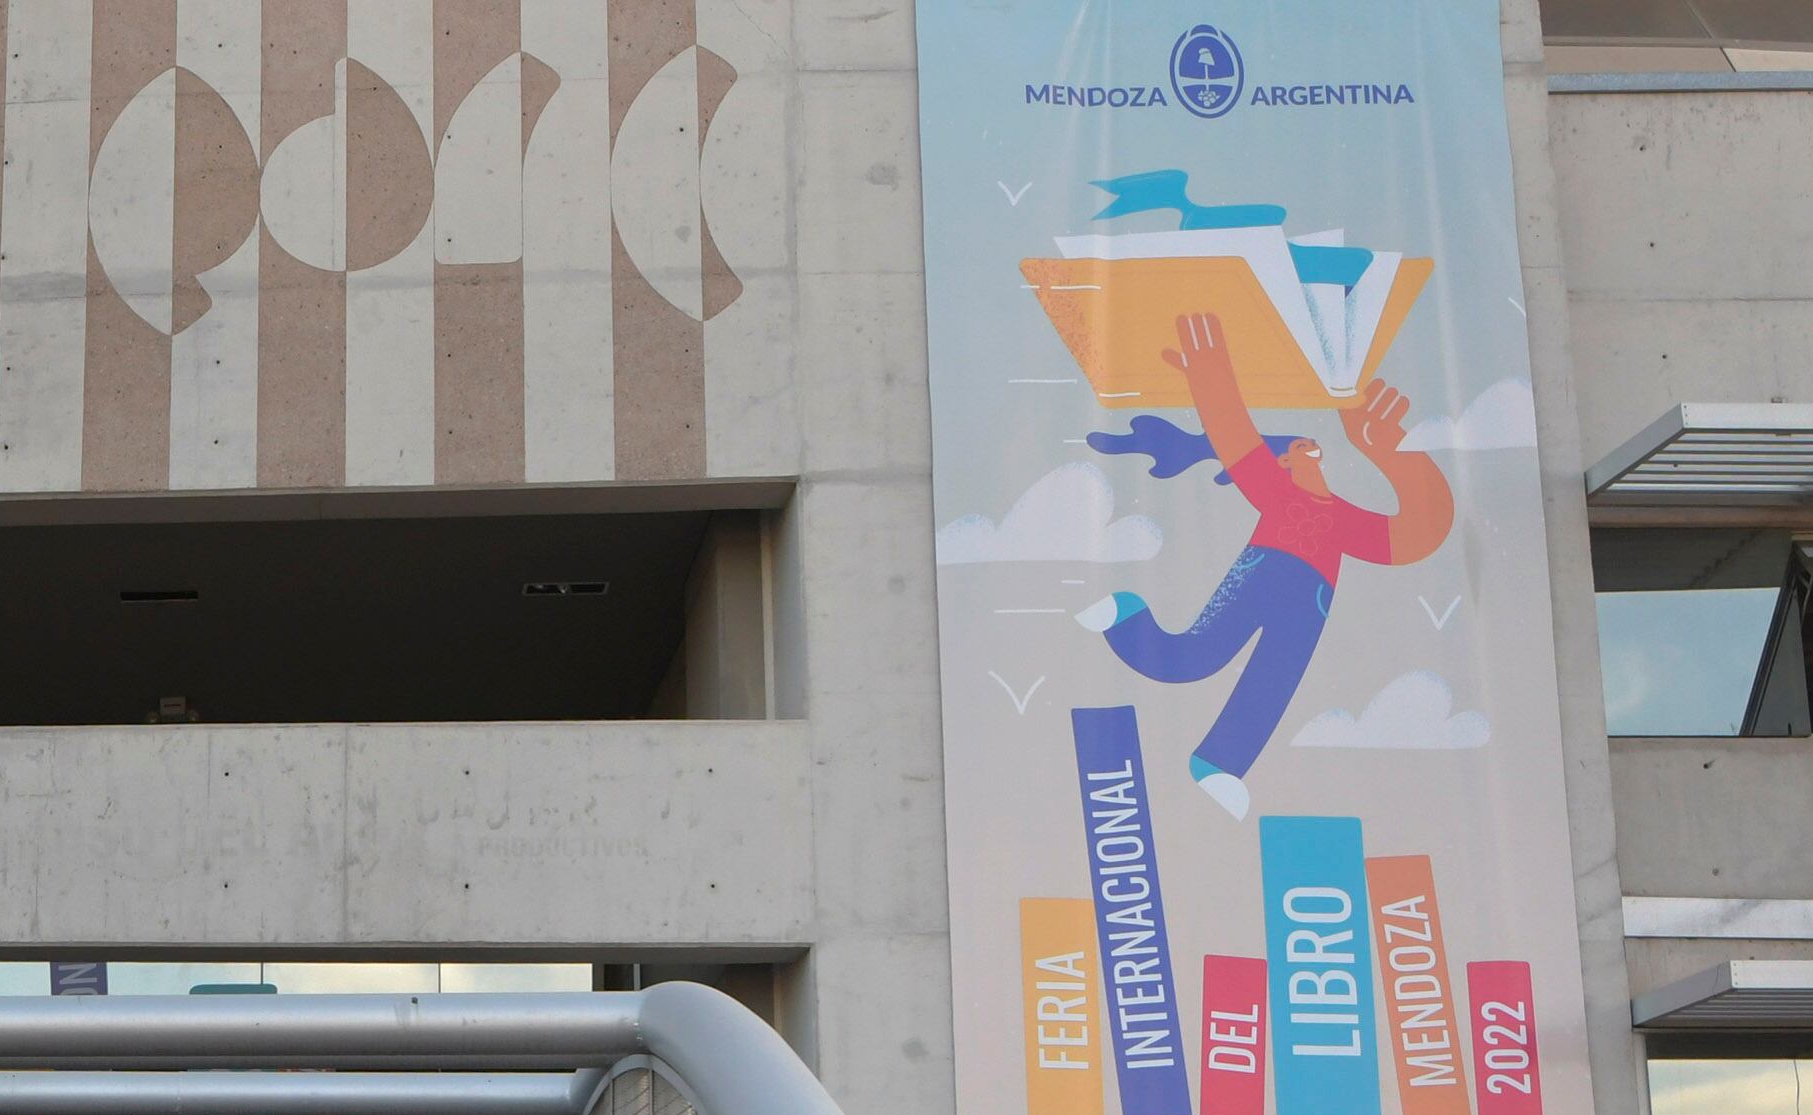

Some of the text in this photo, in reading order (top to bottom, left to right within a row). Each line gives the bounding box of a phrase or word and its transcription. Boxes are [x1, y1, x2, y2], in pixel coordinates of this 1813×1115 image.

[1025, 83, 1415, 108] MENDOZA ARGENTINA
[1086, 758, 1176, 1070] INTERNACIONAL
[1282, 886, 1362, 1057] LIBRO
[1034, 950, 1090, 1071] FERIA
[1207, 1003, 1261, 1075] DEL
[1380, 894, 1457, 1088] MENDOZA
[1482, 1000, 1532, 1095] 2022
